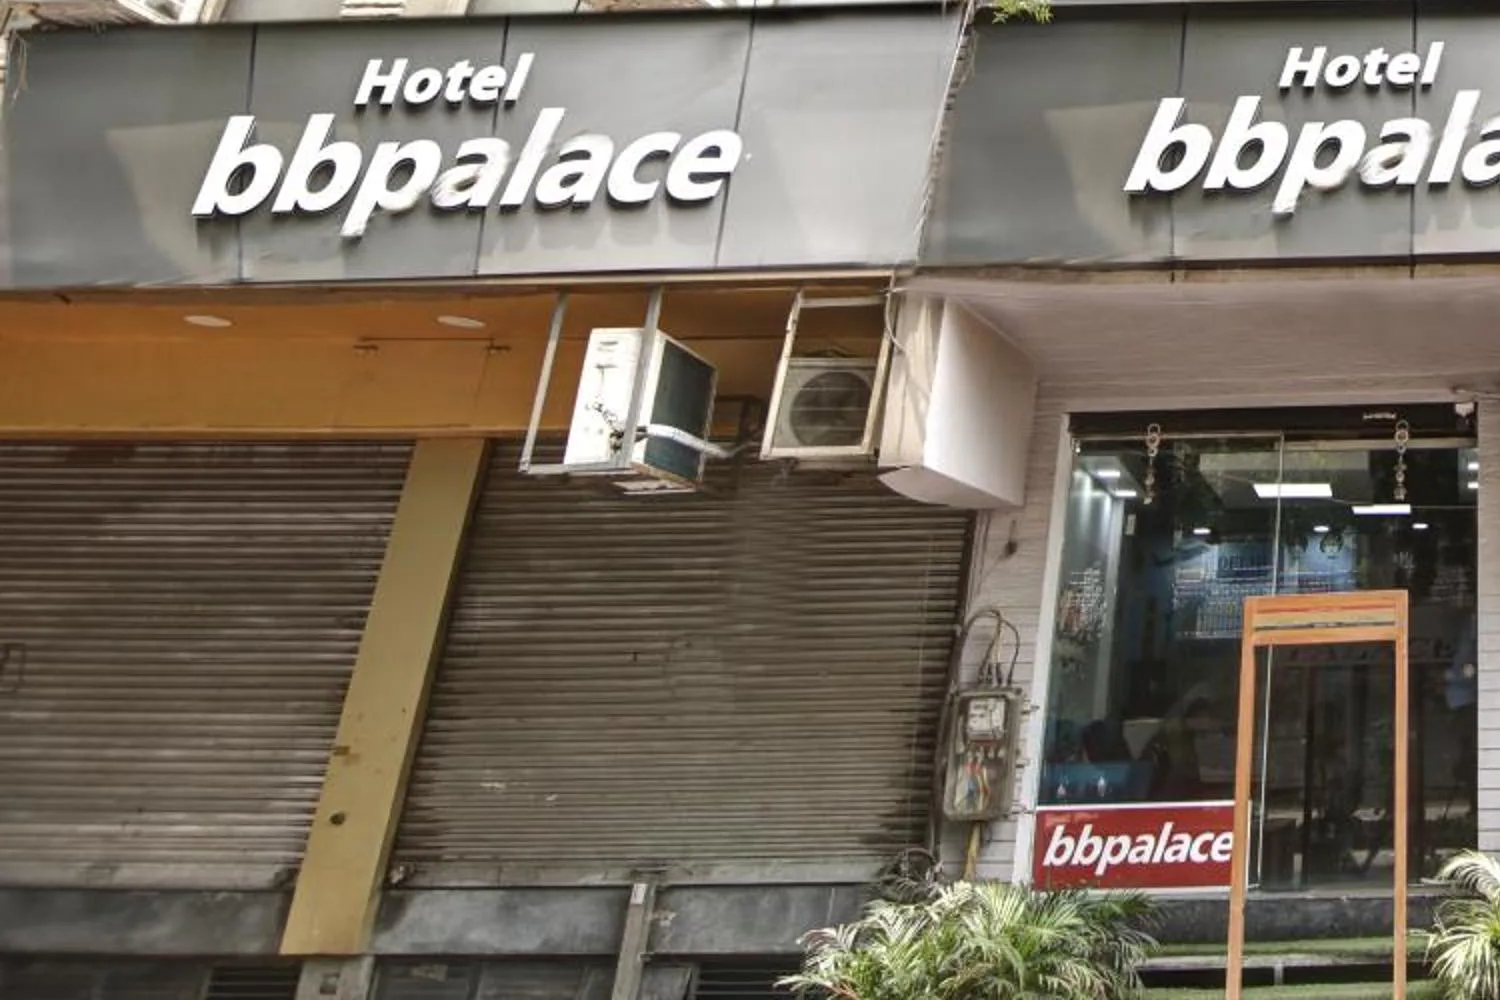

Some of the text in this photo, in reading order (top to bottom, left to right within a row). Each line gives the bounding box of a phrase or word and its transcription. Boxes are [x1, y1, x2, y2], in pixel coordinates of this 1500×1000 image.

[353, 52, 535, 107] Hotel
[1278, 41, 1444, 90] Hotel
[191, 106, 743, 238] bbpalace
[1043, 821, 1235, 876] bbpalace
